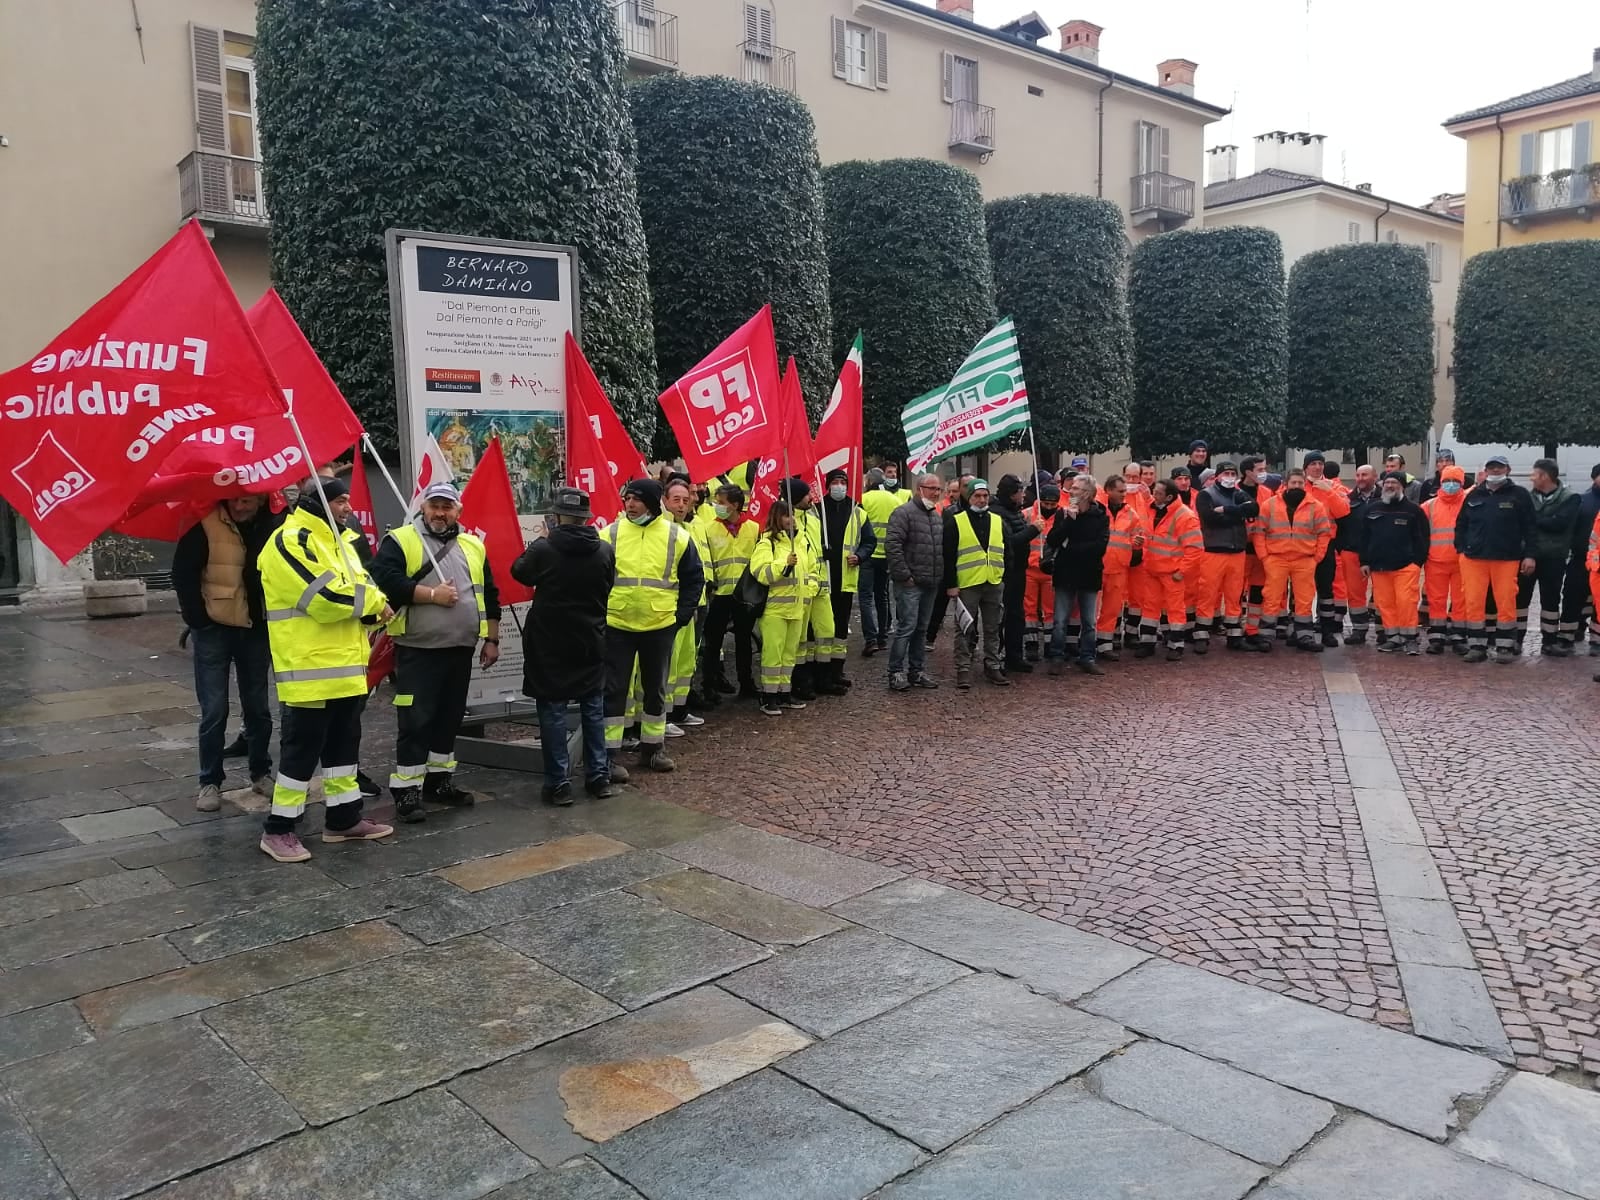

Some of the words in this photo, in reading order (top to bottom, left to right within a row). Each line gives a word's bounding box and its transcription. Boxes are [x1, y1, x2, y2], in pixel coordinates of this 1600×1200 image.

[446, 256, 529, 275] BERNARD
[441, 273, 533, 293] DAMIANO
[467, 303, 507, 314] Piemont
[519, 306, 541, 316] Paris
[436, 312, 454, 322] Dal
[456, 314, 503, 326] Piemonte
[434, 383, 473, 391] Restituzione
[508, 372, 543, 396] Alpi
